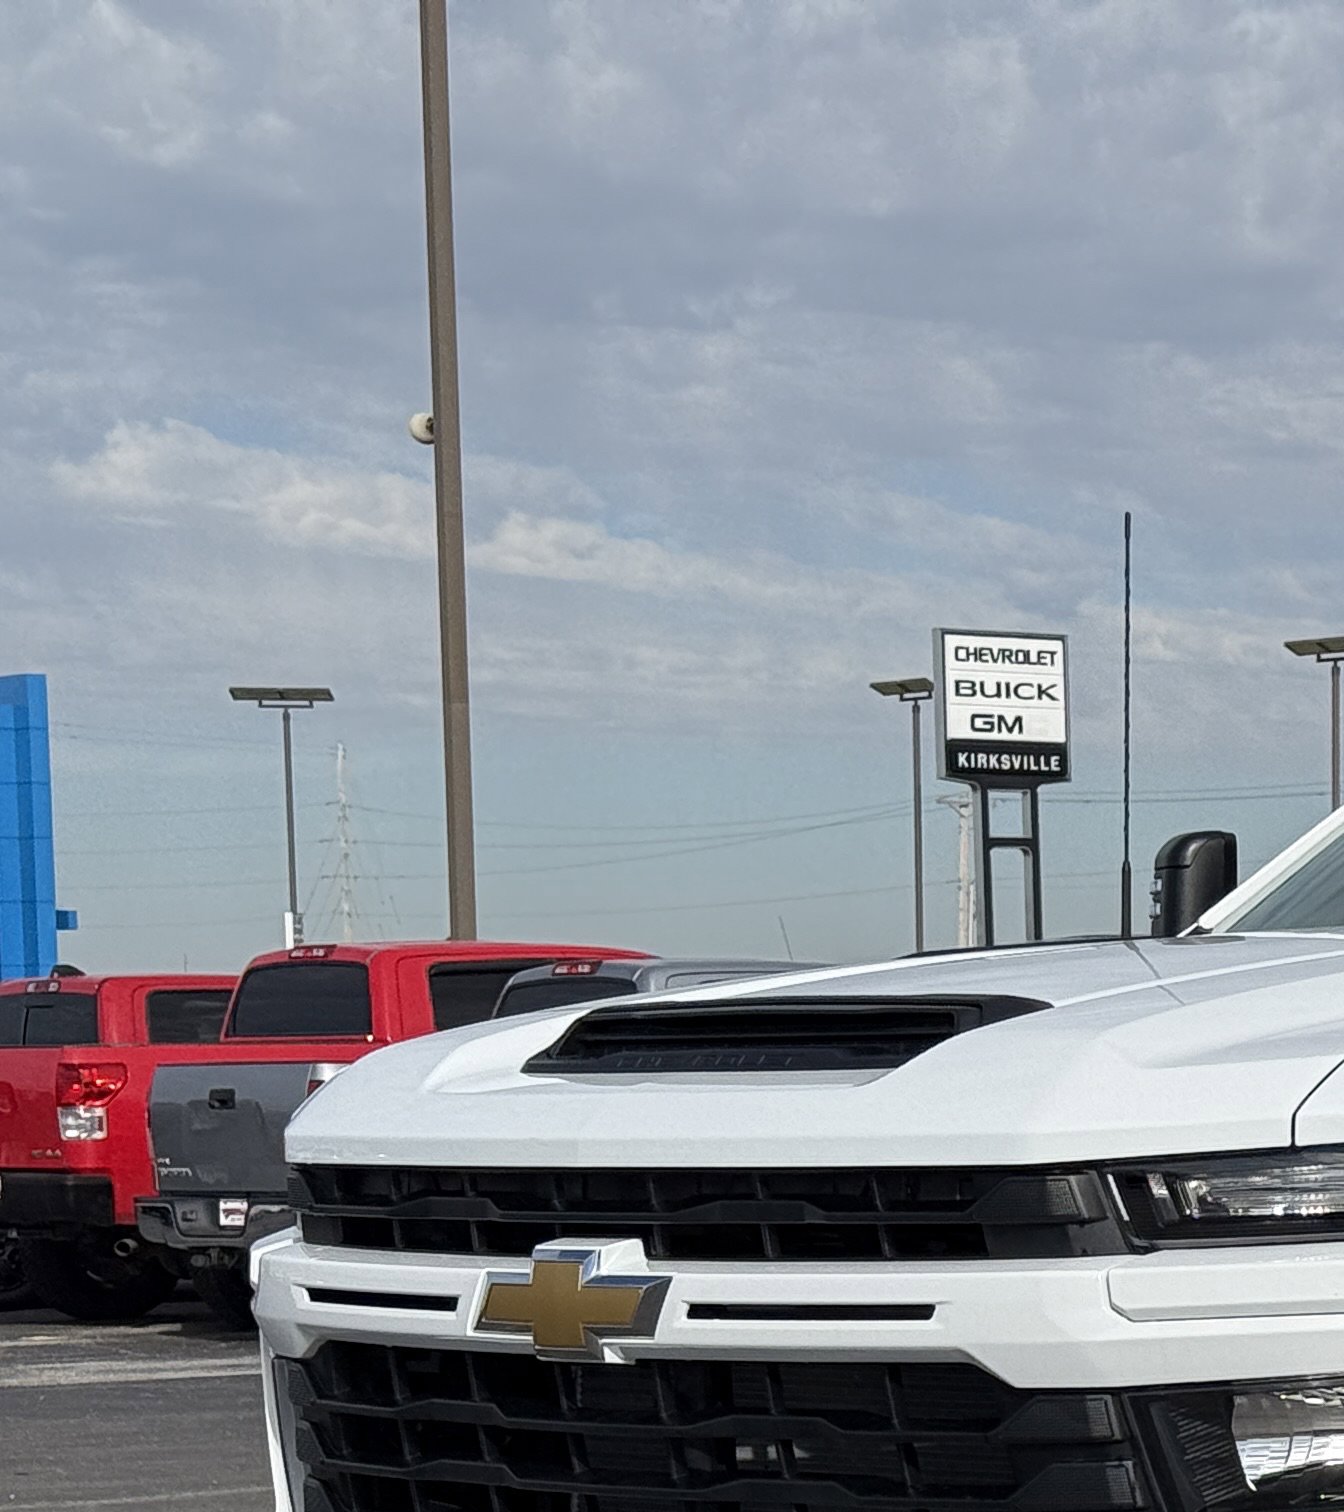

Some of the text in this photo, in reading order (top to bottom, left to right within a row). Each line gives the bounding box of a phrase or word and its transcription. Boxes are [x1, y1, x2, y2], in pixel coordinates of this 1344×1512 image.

[954, 645, 1058, 667] CHEVROLET
[954, 679, 1060, 702] BUICK
[970, 713, 1024, 735] GM
[958, 751, 1062, 772] KIRKSVILLE
